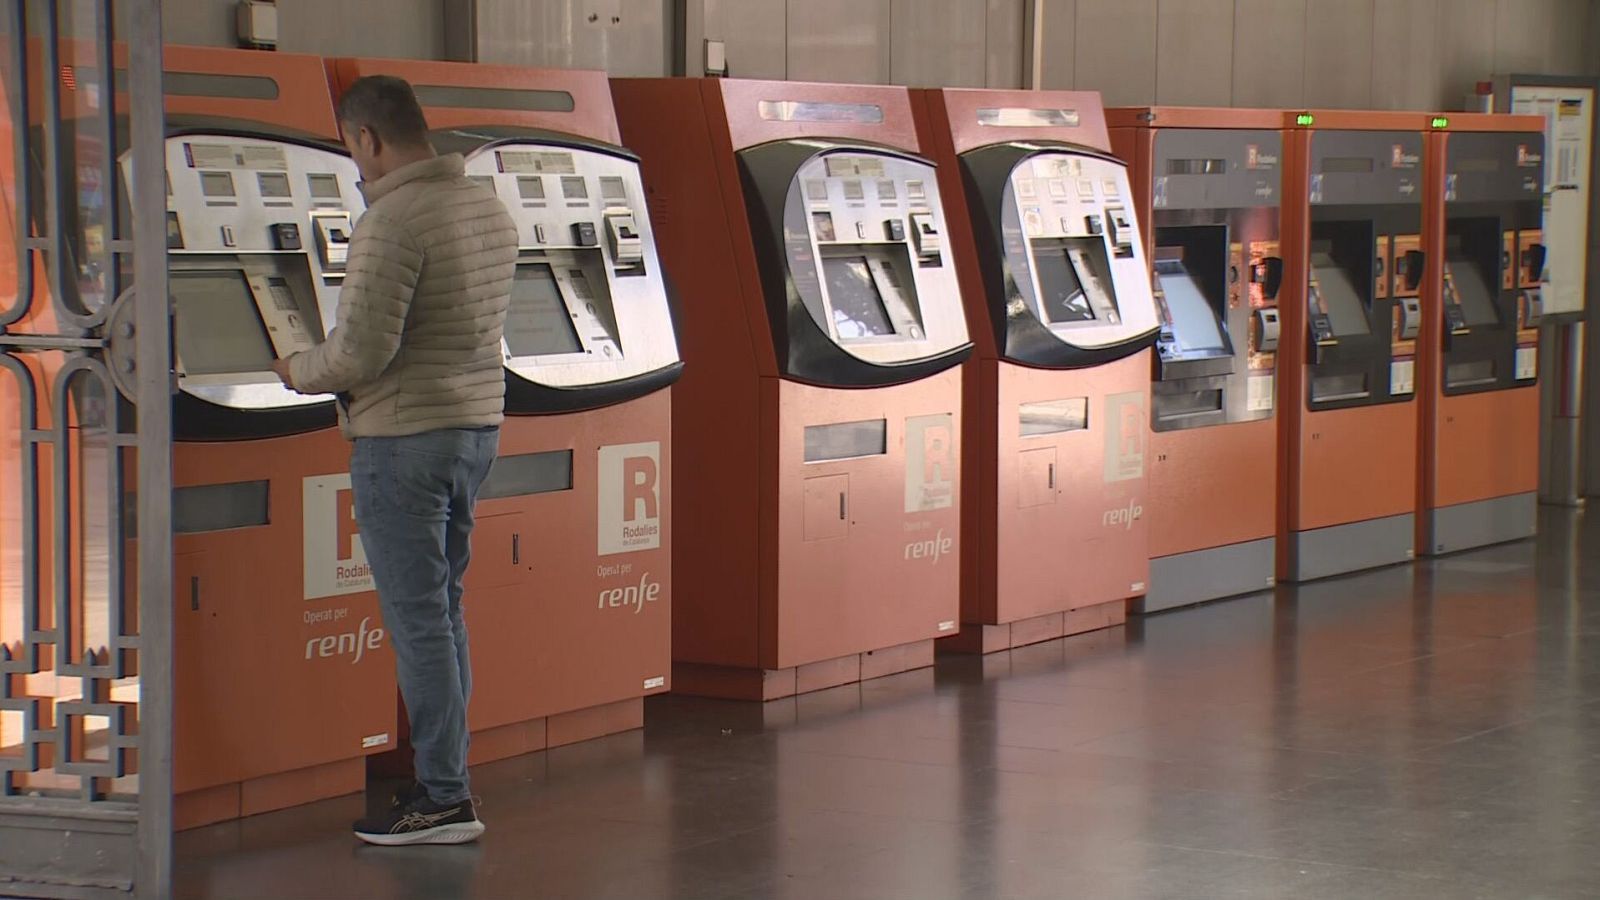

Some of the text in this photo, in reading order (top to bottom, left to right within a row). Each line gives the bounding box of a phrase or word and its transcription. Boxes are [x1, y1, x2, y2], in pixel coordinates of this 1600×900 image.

[923, 424, 952, 482] R
[623, 455, 658, 522] R
[623, 524, 658, 539] Rodalies
[1103, 498, 1143, 532] renfe
[903, 528, 953, 565] renfe
[597, 562, 632, 578] Operat per
[597, 571, 661, 615] renfe
[303, 607, 348, 625] Operat per
[304, 616, 385, 665] renfe
